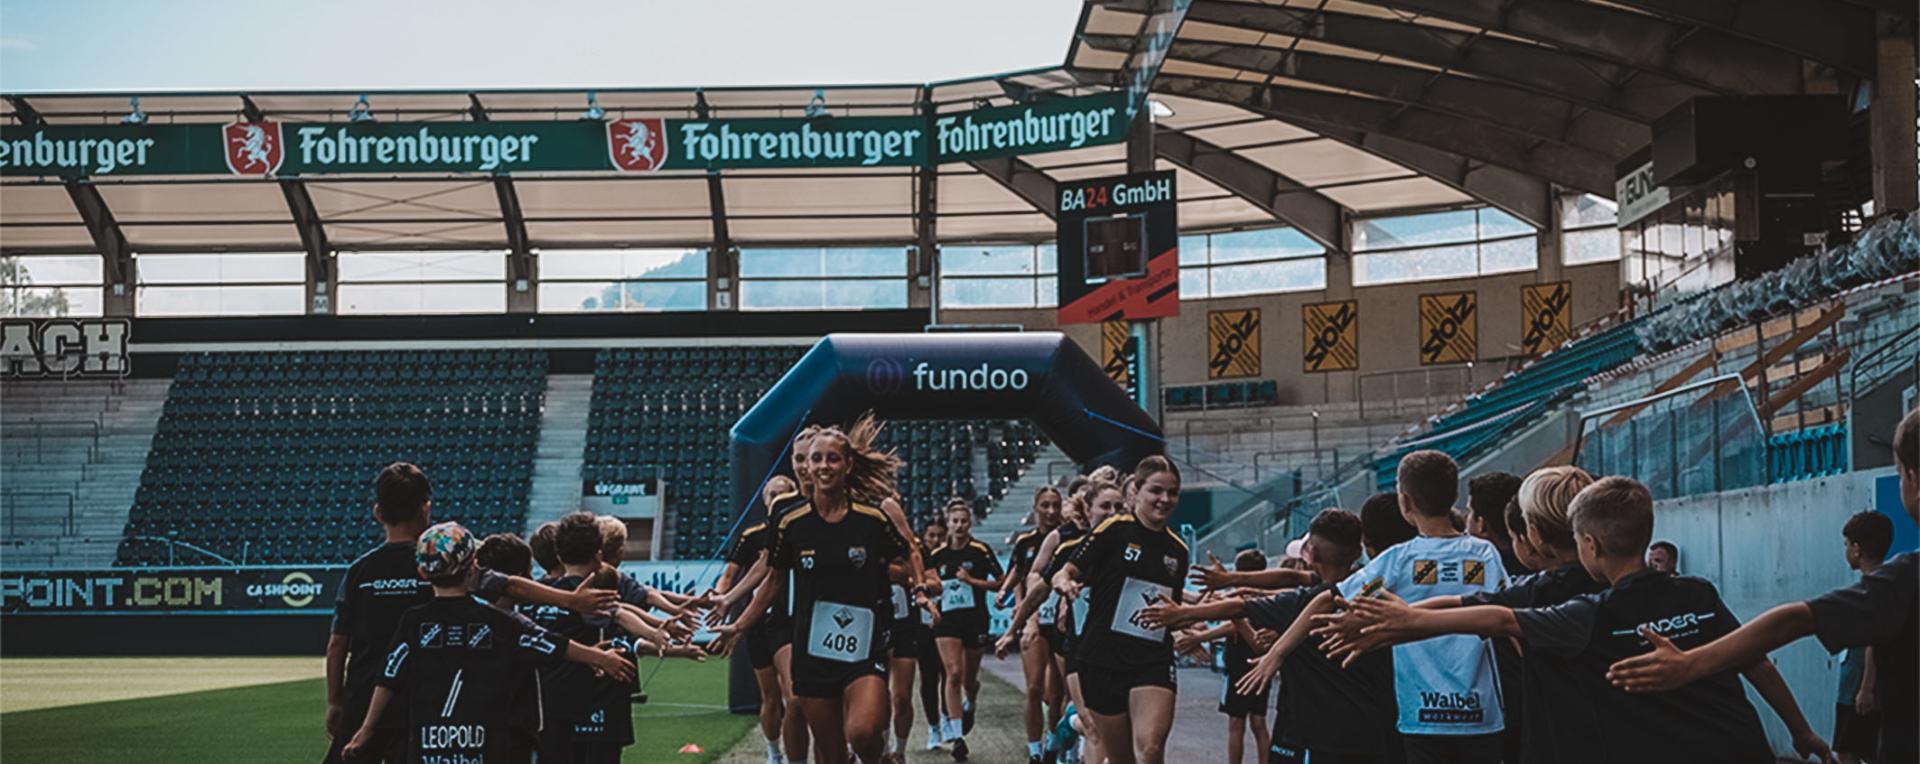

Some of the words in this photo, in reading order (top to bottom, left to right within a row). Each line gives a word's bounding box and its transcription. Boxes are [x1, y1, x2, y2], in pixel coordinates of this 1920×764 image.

[681, 122, 922, 166] Fohrenburger
[936, 107, 1115, 155] Fohrenburger
[298, 127, 538, 170] Fohrenburger
[1061, 186, 1107, 211] BA24
[1112, 179, 1171, 205] GmbH
[0, 322, 127, 373] ACH
[913, 362, 1028, 390] fundoo
[1123, 546, 1142, 562] 57
[246, 582, 323, 598] CASHPOINT
[822, 632, 858, 654] 408
[1420, 691, 1481, 709] Waibel
[421, 724, 485, 749] LEOPOLD
